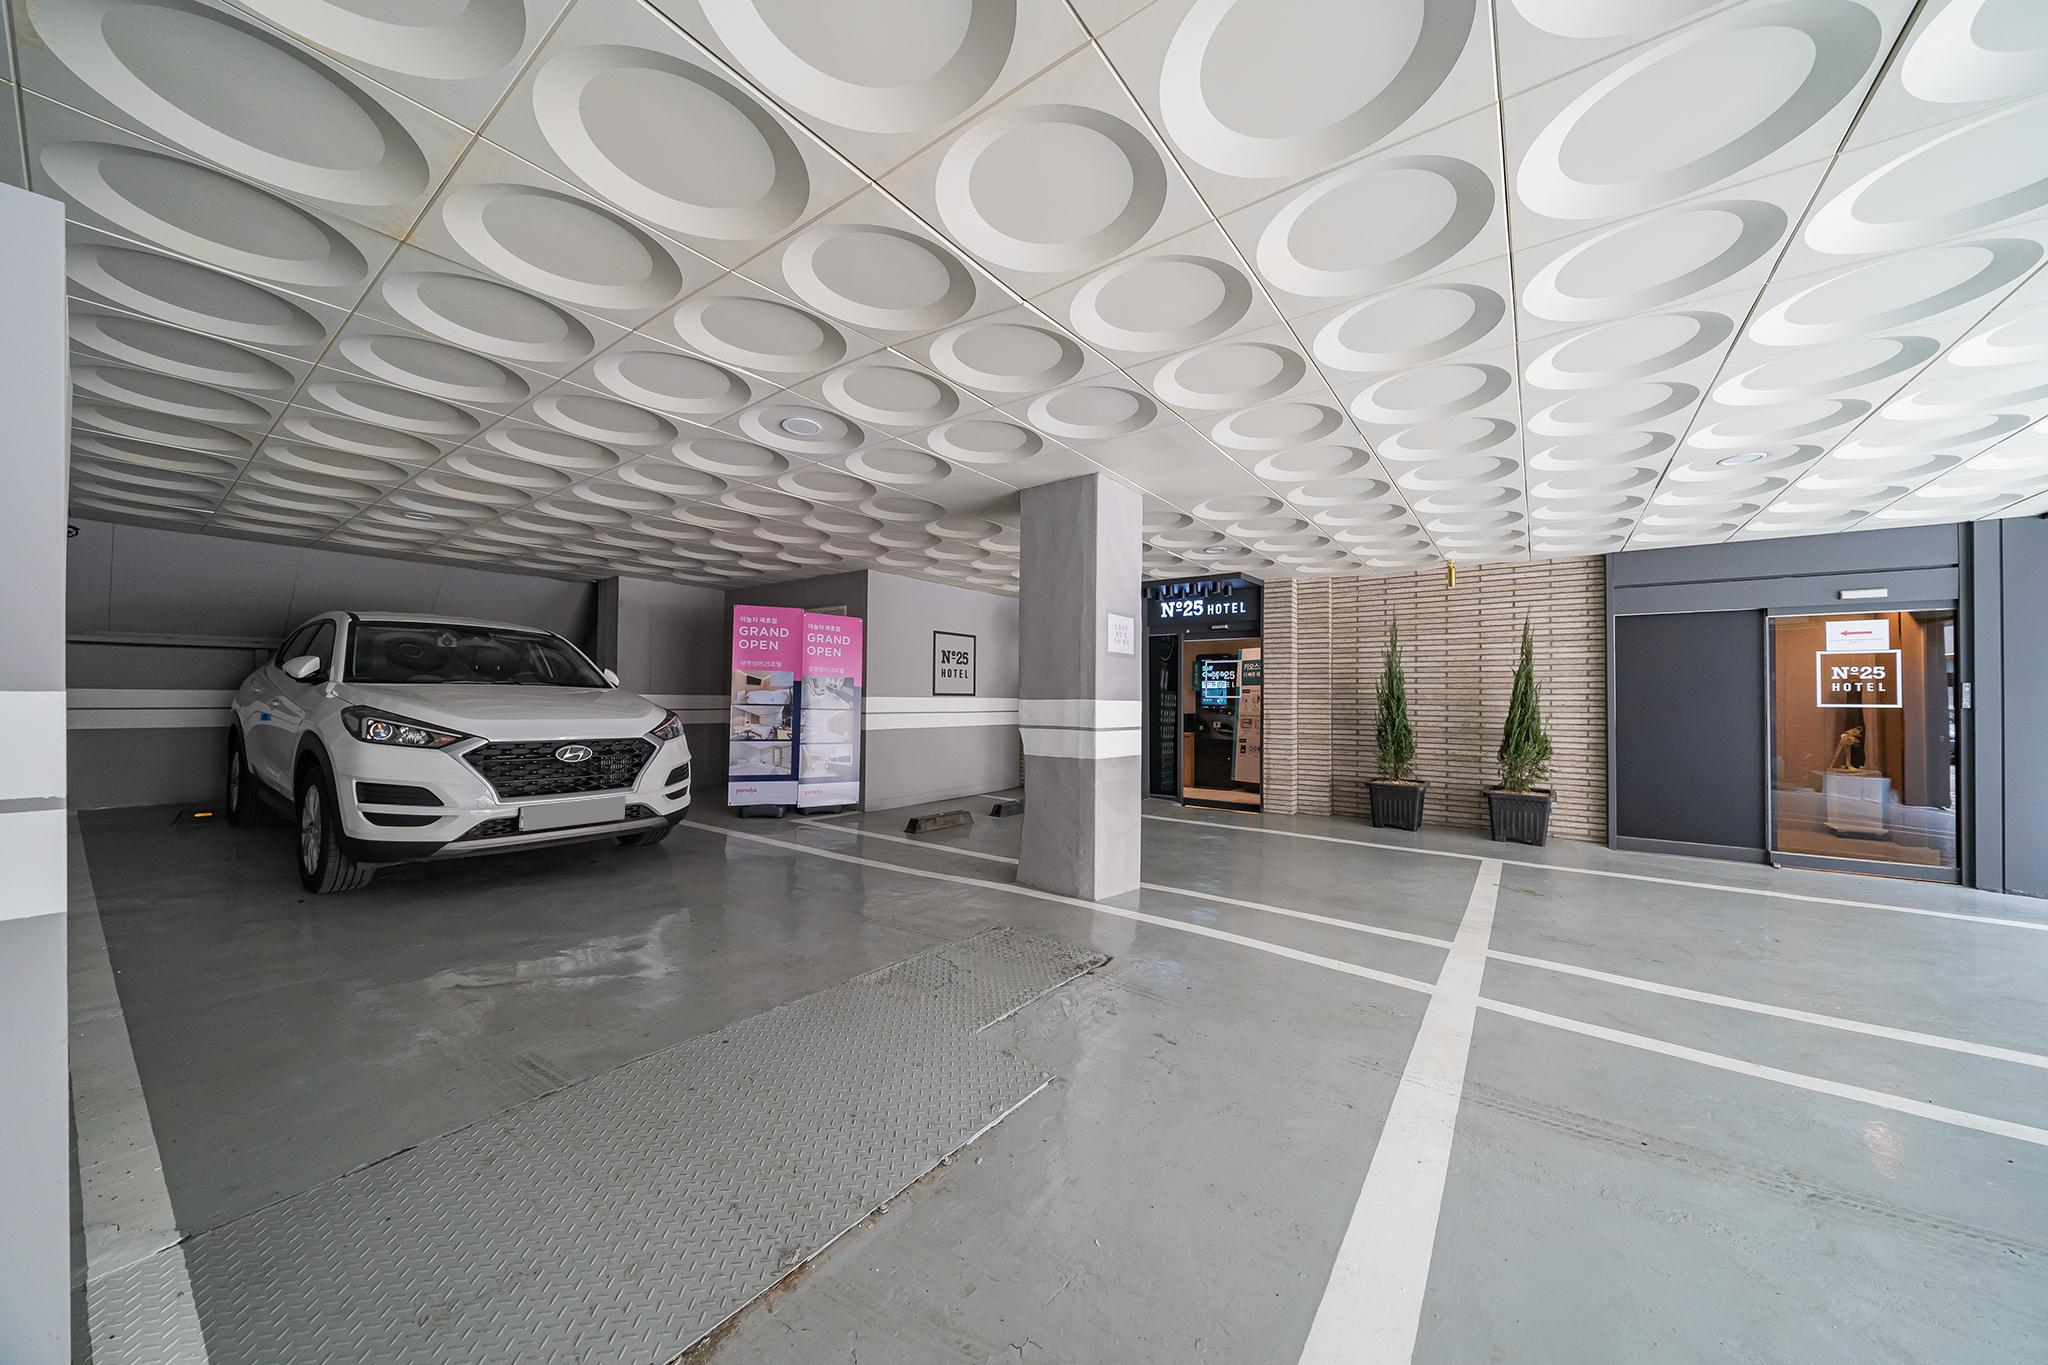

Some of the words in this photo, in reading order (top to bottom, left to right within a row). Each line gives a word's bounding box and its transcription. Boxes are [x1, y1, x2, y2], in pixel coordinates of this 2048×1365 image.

[1207, 602, 1246, 615] HOTEL
[739, 626, 790, 638] GRAND
[738, 639, 779, 651] OPEN
[807, 633, 851, 645] GRAND
[807, 646, 842, 657] OPEN
[941, 668, 969, 679] HOTEL
[1831, 682, 1886, 692] HOTEL
